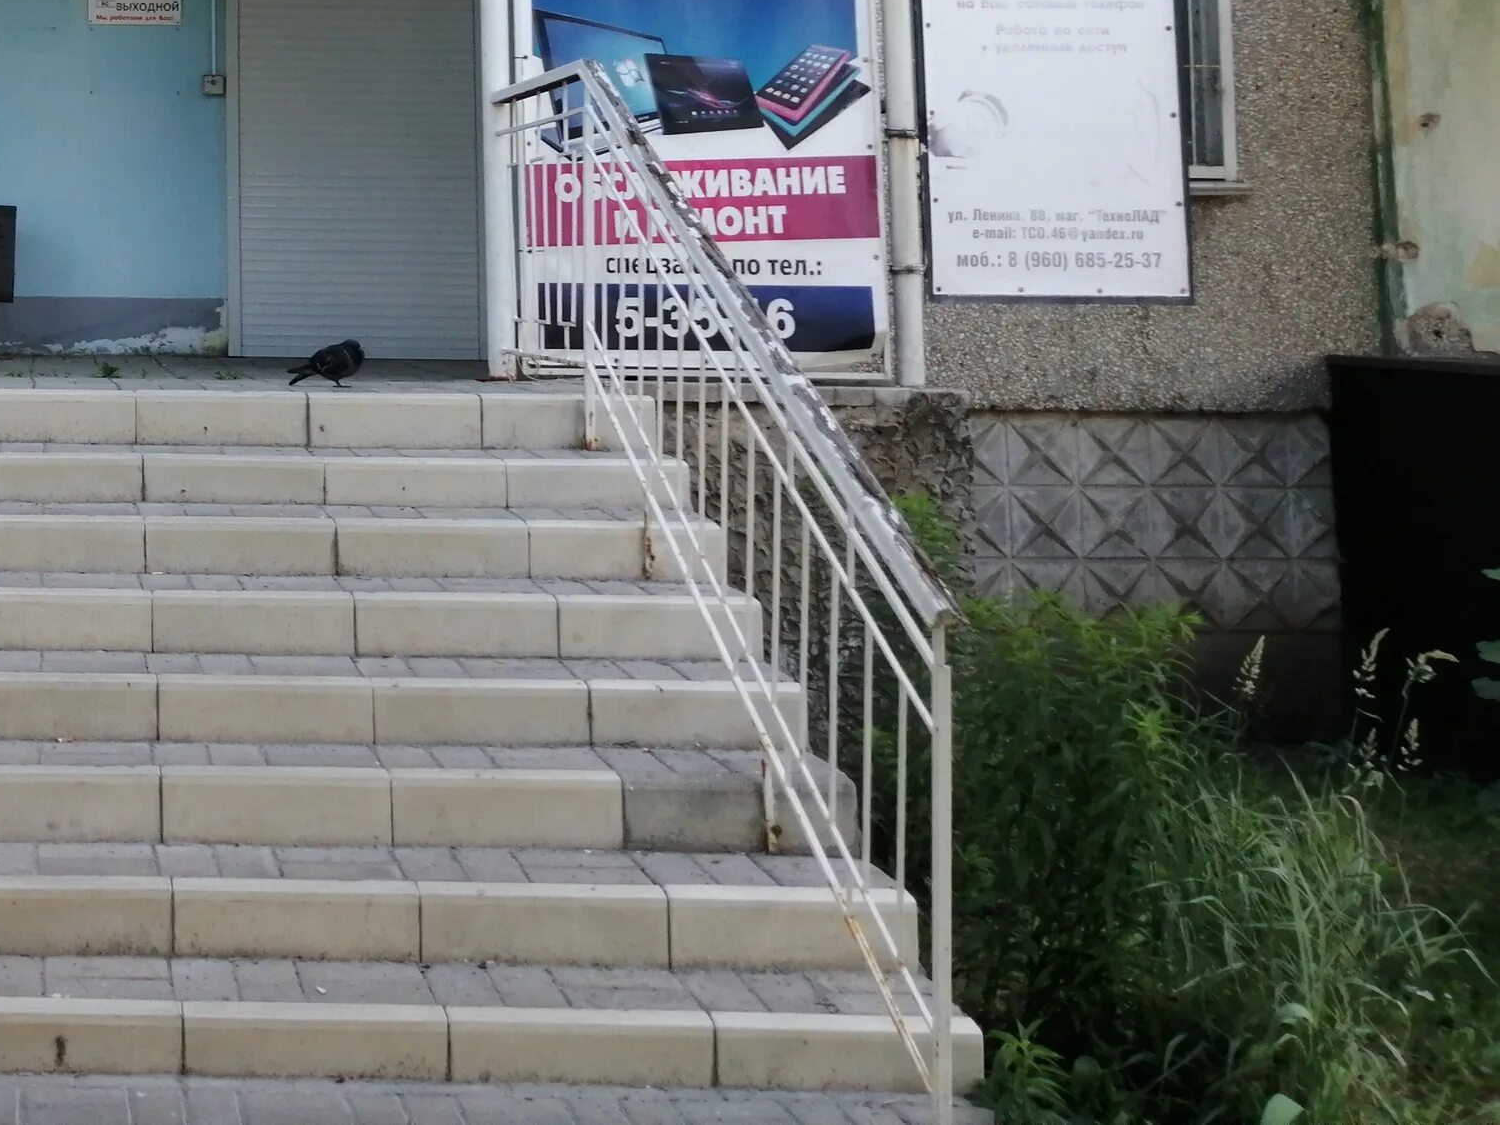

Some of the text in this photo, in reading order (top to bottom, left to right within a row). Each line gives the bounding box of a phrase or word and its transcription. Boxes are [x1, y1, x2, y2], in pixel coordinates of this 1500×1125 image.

[116, 0, 180, 13] ВЫХОДНОЙ
[554, 165, 847, 204] ОБСЛЖИВАНИЕ
[650, 205, 787, 238] РМОНТ
[947, 210, 968, 224] ул.
[972, 226, 1016, 239] e-mail:
[733, 258, 760, 276] по
[768, 258, 823, 276] тел.:
[956, 251, 1162, 272] моб.: 8 (960) 685-25-37
[615, 297, 797, 339] 5-35-6
